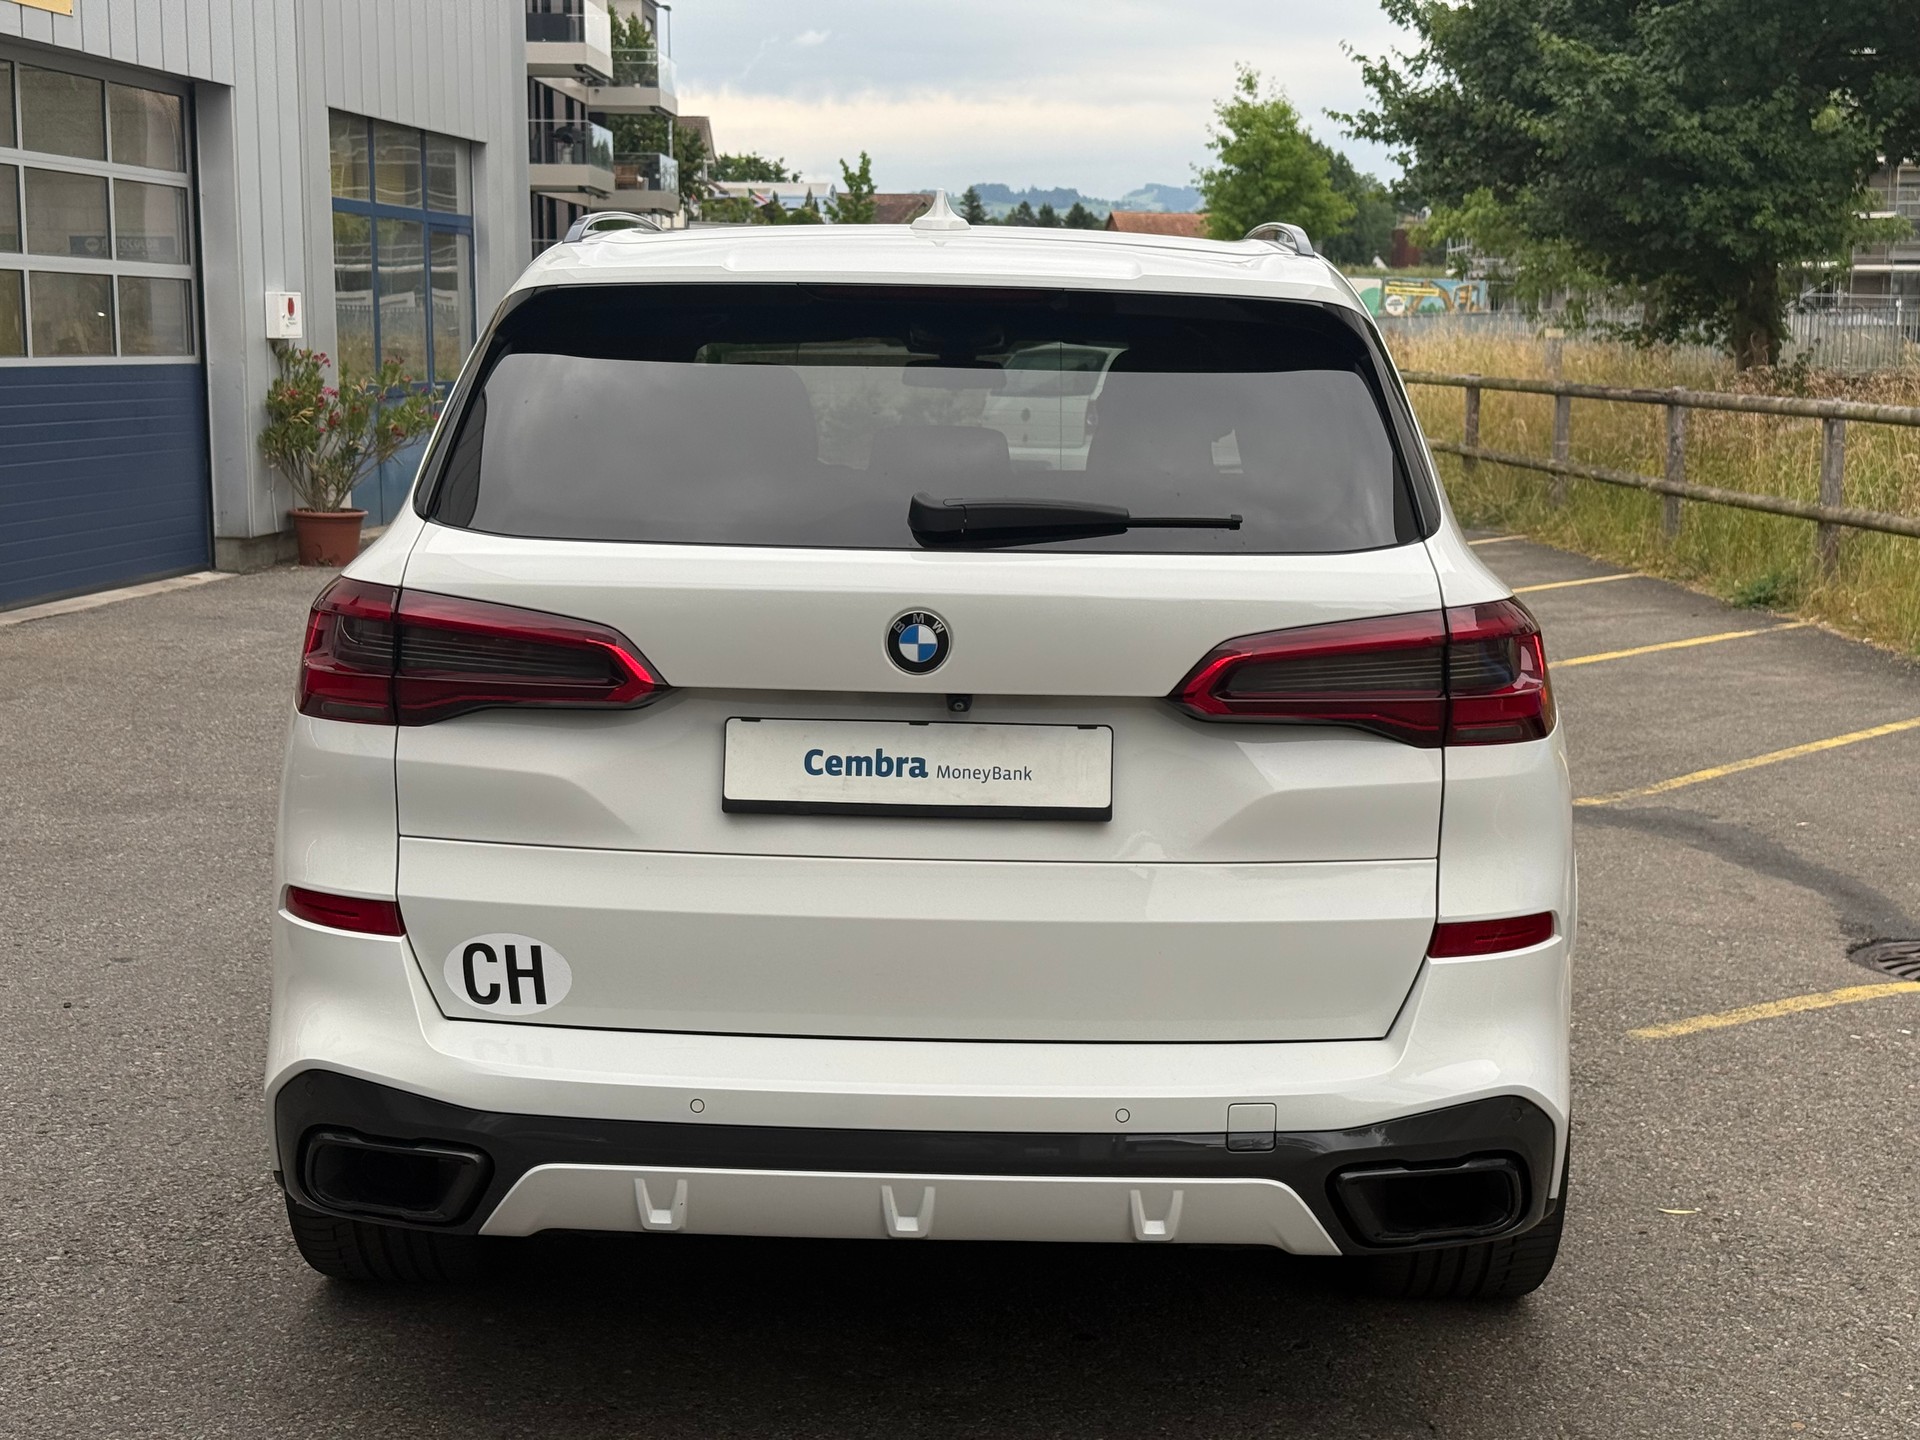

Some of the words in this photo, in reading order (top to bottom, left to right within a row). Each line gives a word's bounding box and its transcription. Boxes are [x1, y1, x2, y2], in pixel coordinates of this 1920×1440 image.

[893, 613, 945, 634] BMW
[803, 748, 929, 779] Cembra
[936, 765, 1033, 784] MoneyBank
[462, 942, 547, 1005] CH
